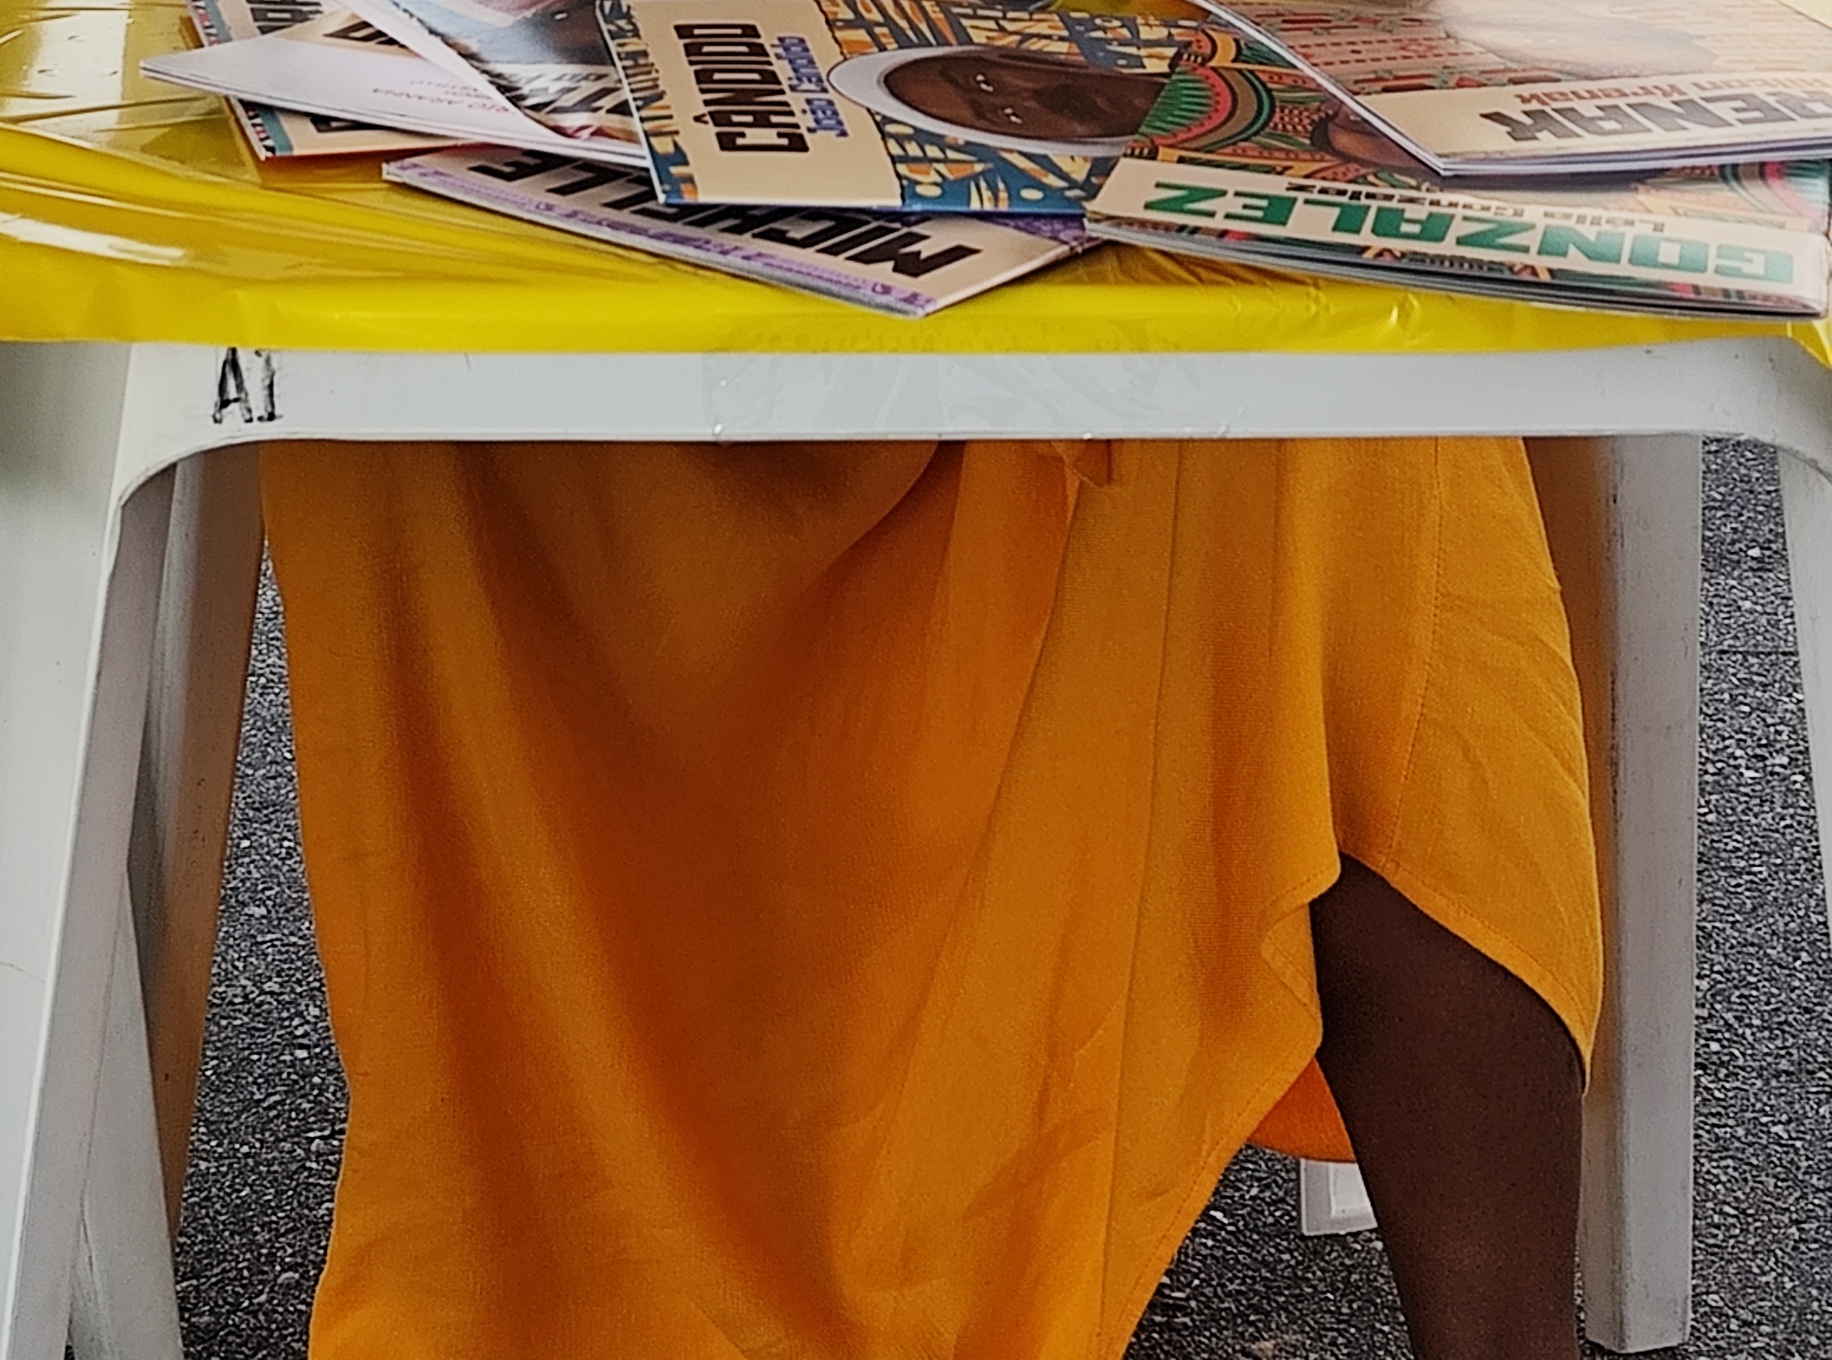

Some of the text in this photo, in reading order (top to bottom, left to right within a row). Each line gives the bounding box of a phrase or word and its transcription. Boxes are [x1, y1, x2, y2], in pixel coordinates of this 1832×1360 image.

[673, 22, 810, 153] CÂNDIDO
[770, 35, 848, 138] João Cândido
[1144, 181, 1795, 285] GONZALEZ
